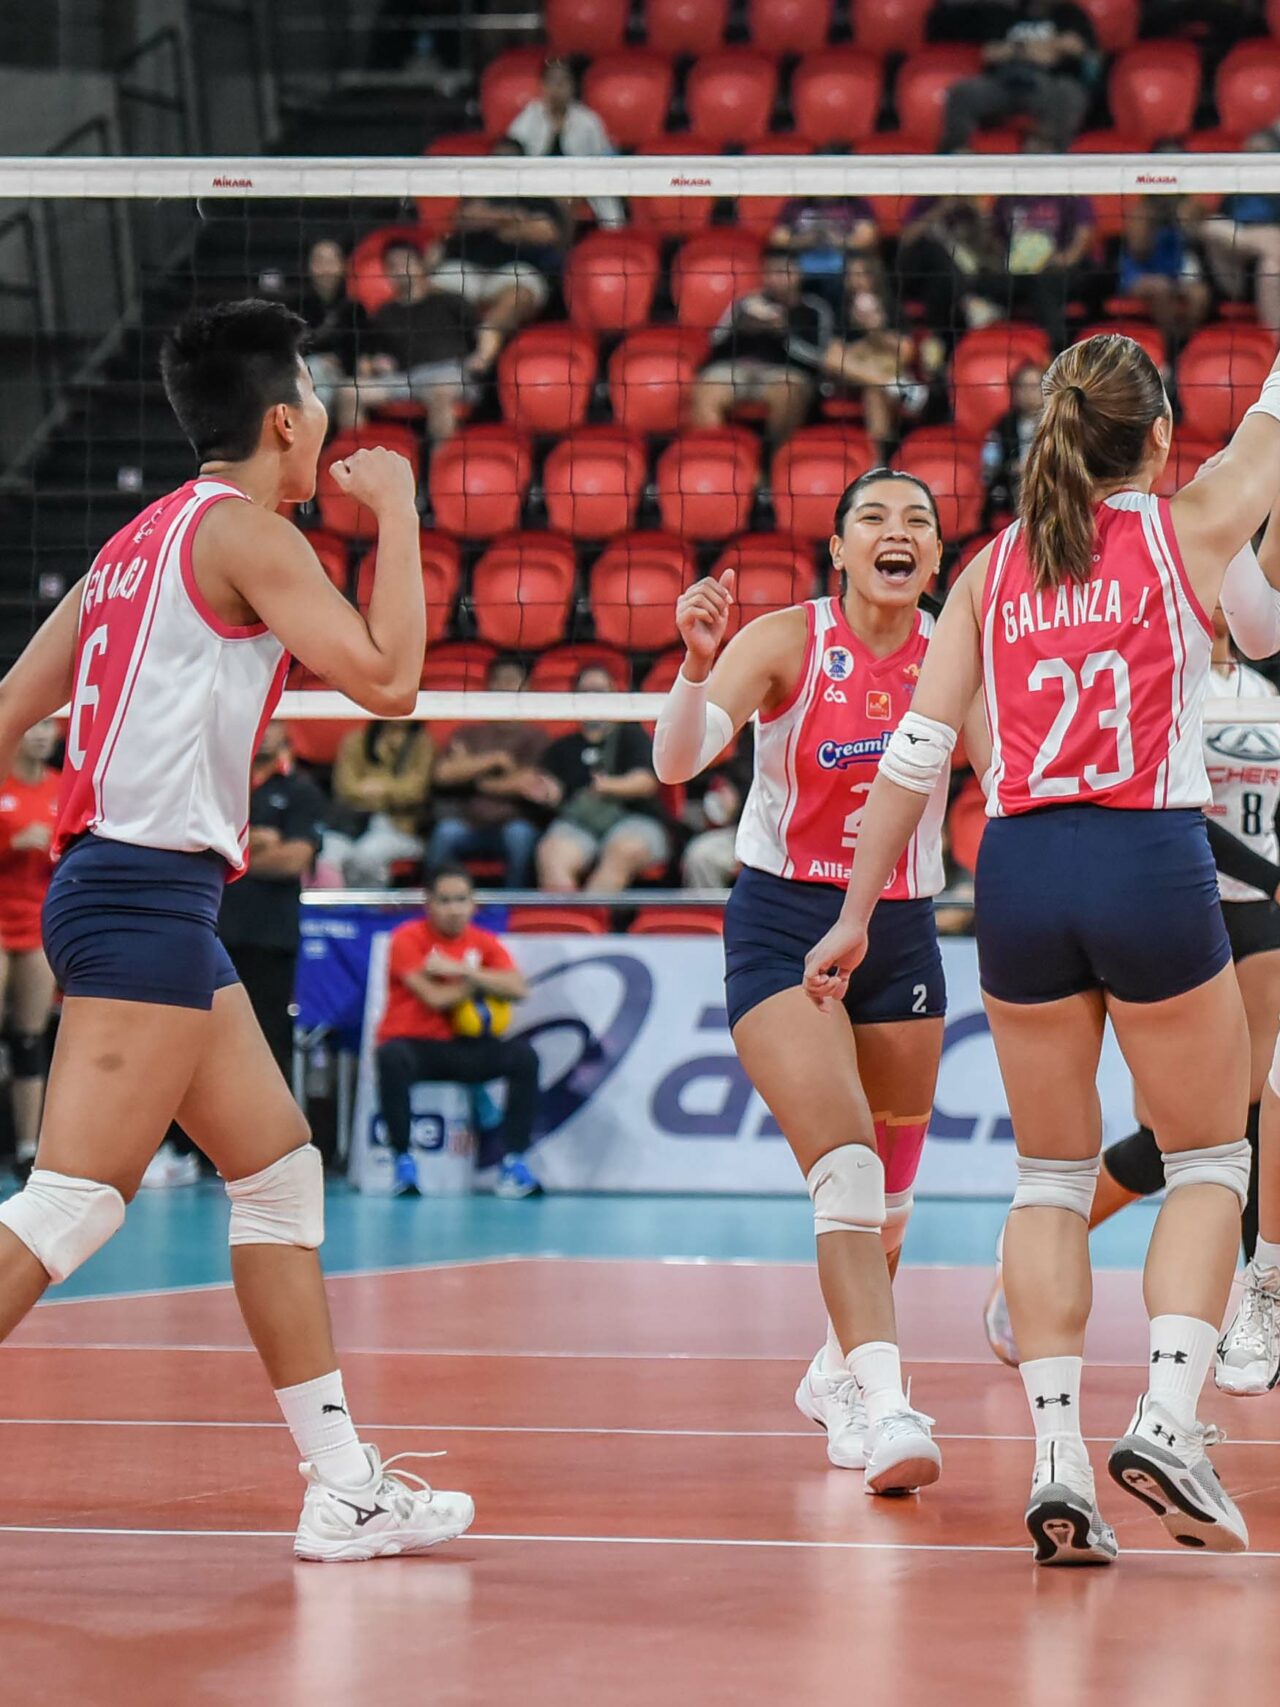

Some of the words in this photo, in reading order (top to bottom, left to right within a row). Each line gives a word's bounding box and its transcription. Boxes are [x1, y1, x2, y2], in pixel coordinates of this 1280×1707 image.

[1002, 579, 1122, 643] GALANZA
[1132, 586, 1150, 629] J.
[67, 624, 108, 771] 6
[1027, 650, 1135, 798] 23
[1242, 792, 1262, 835] 8
[911, 983, 927, 1014] 2
